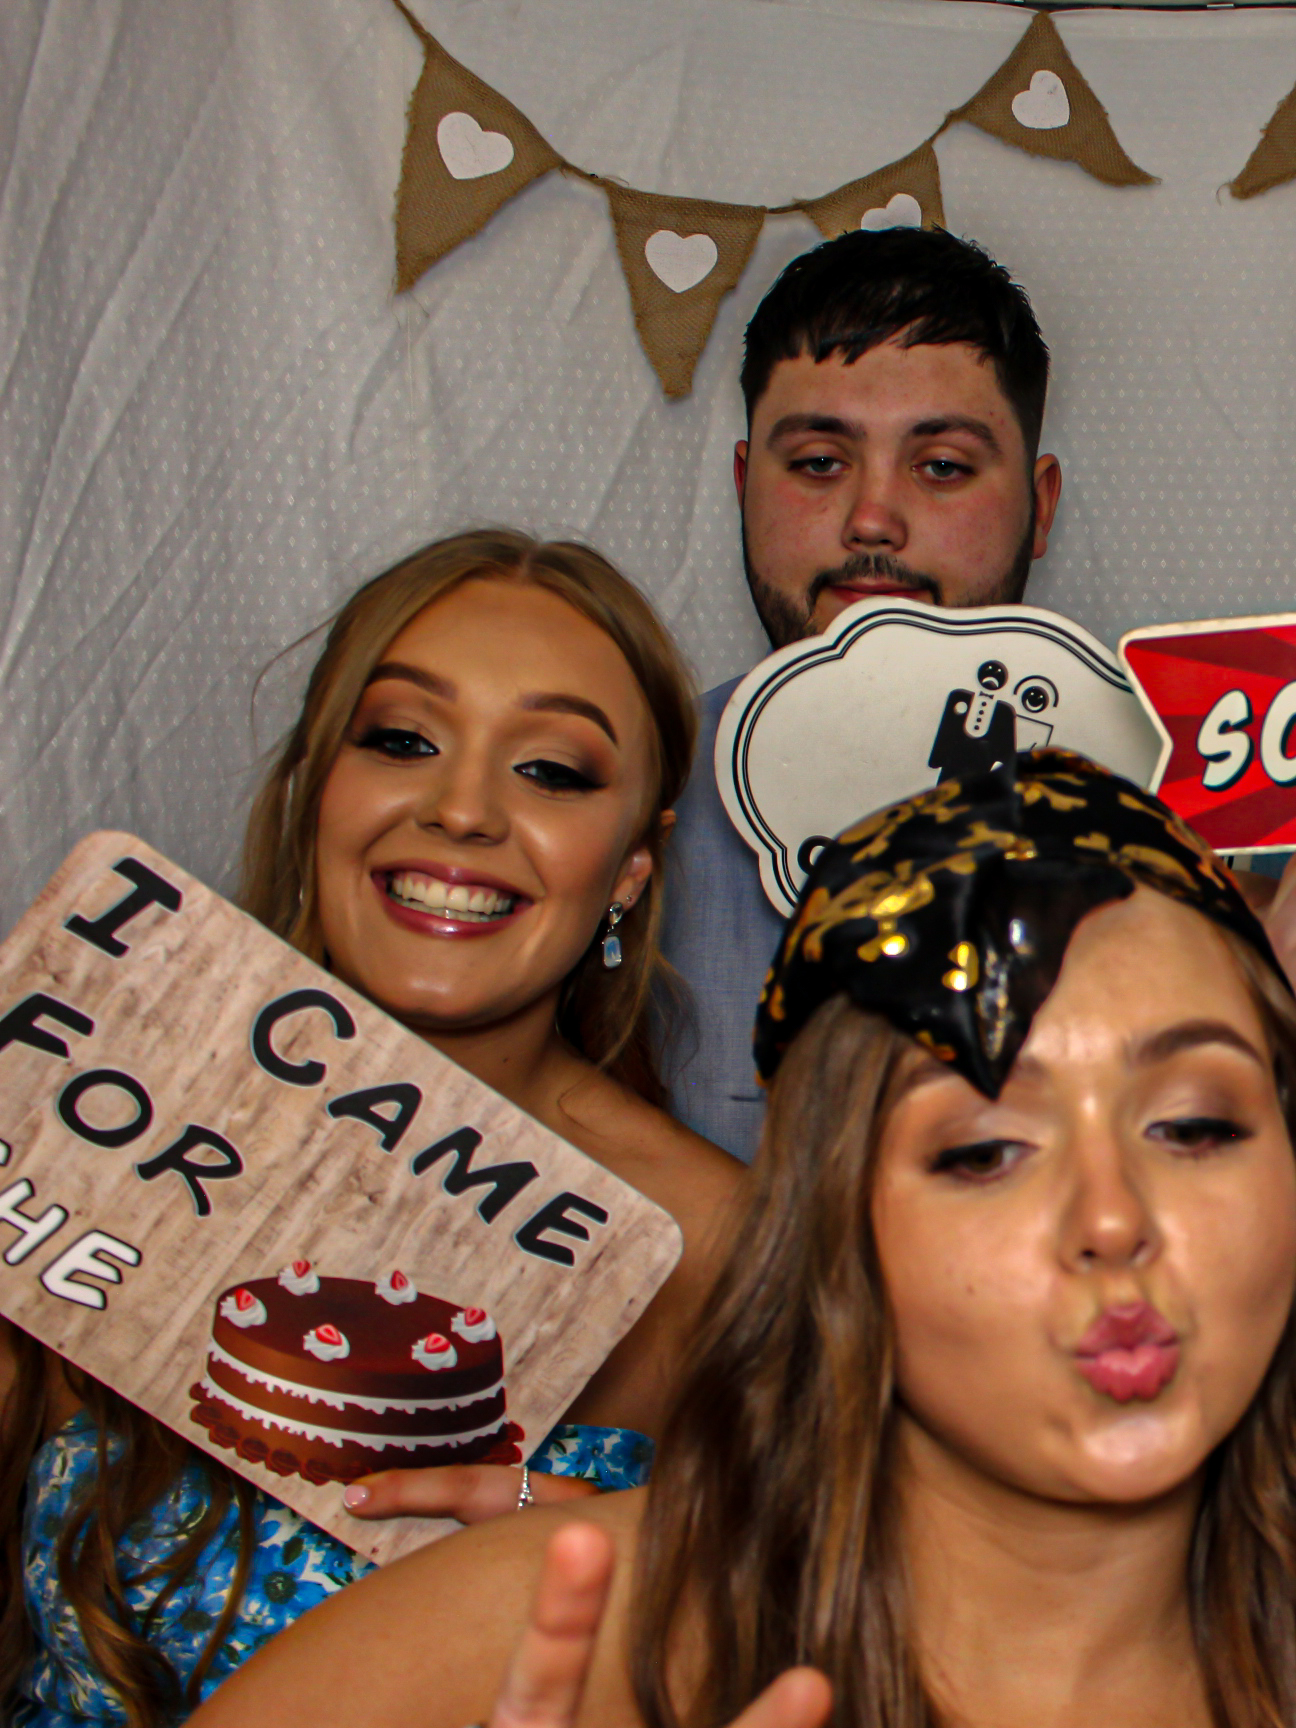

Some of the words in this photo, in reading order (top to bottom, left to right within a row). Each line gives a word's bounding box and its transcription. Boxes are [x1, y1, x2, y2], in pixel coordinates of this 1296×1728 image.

[0, 992, 244, 1216] FOR
[64, 857, 183, 958] I
[250, 989, 609, 1267] CAME
[0, 1138, 143, 1311] HE
